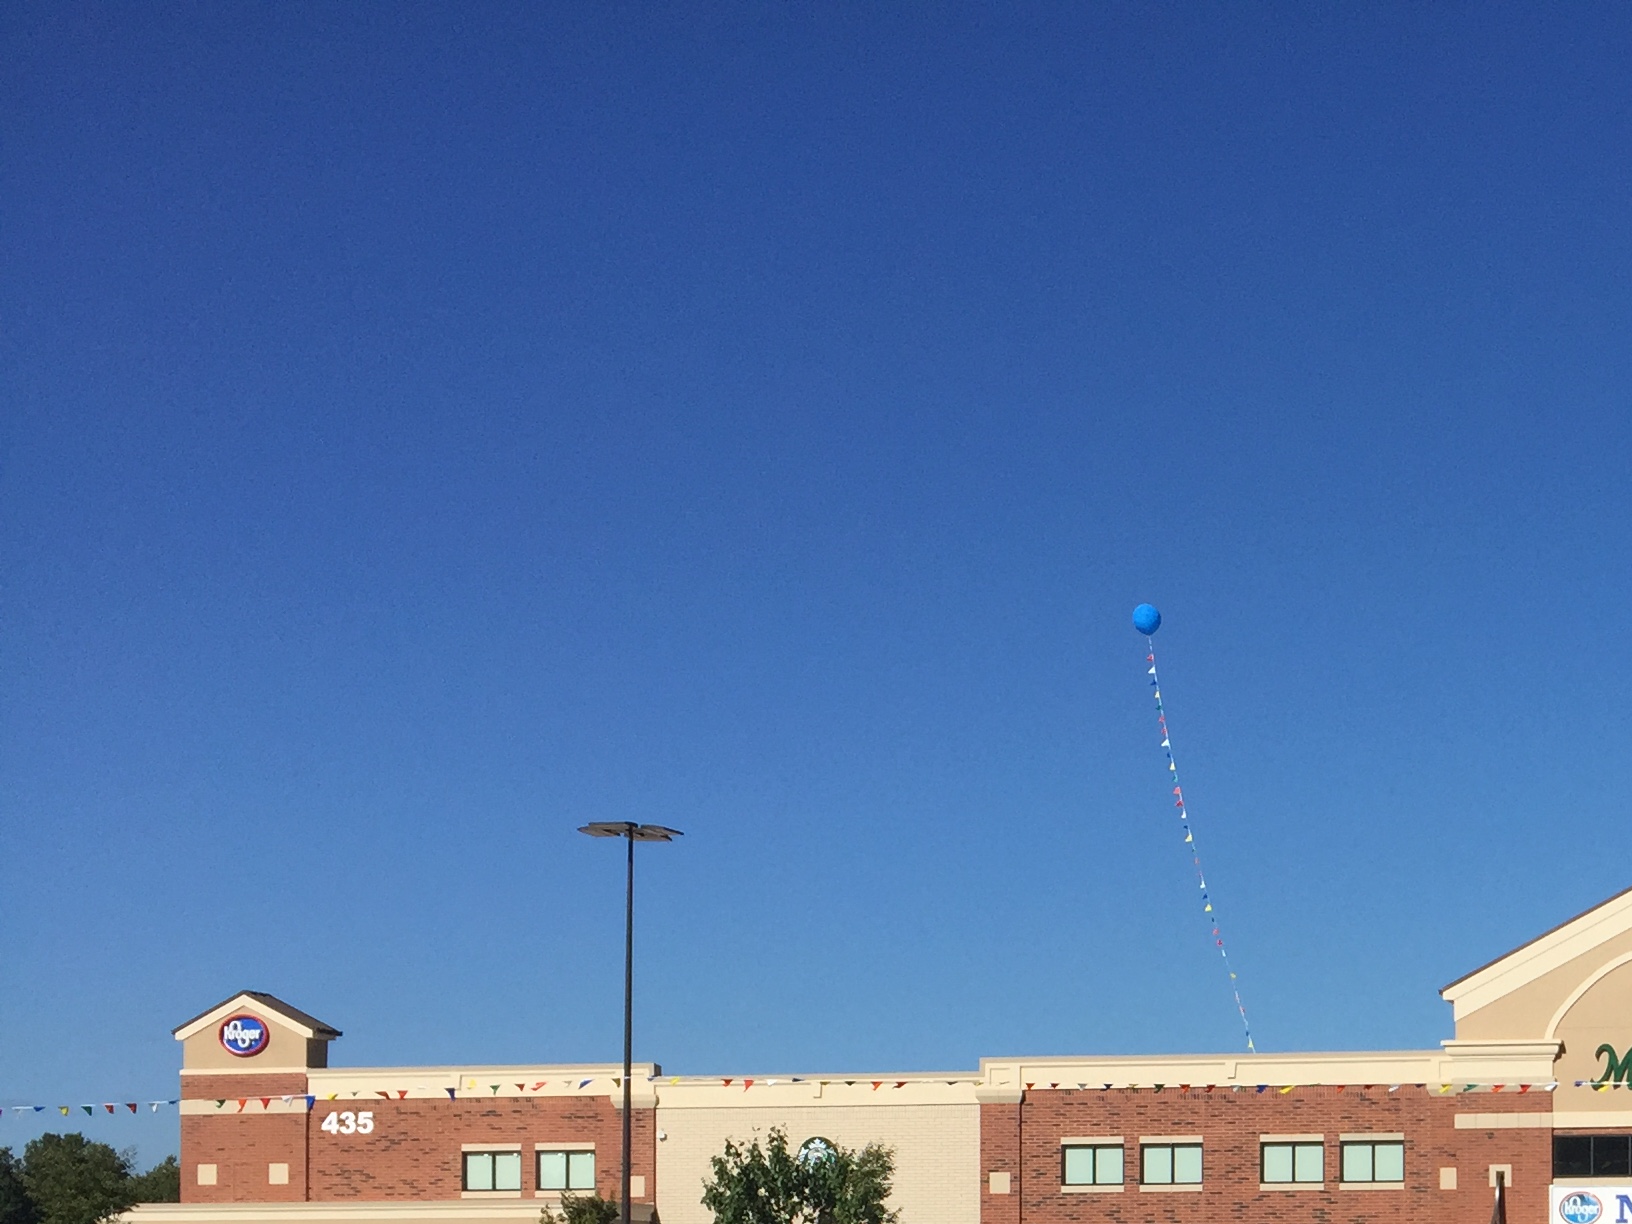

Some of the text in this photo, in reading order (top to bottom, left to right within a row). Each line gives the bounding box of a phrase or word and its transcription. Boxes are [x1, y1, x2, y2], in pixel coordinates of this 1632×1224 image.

[223, 1020, 261, 1048] Kroger
[321, 1111, 374, 1135] 435
[1564, 1195, 1600, 1223] Kroger
